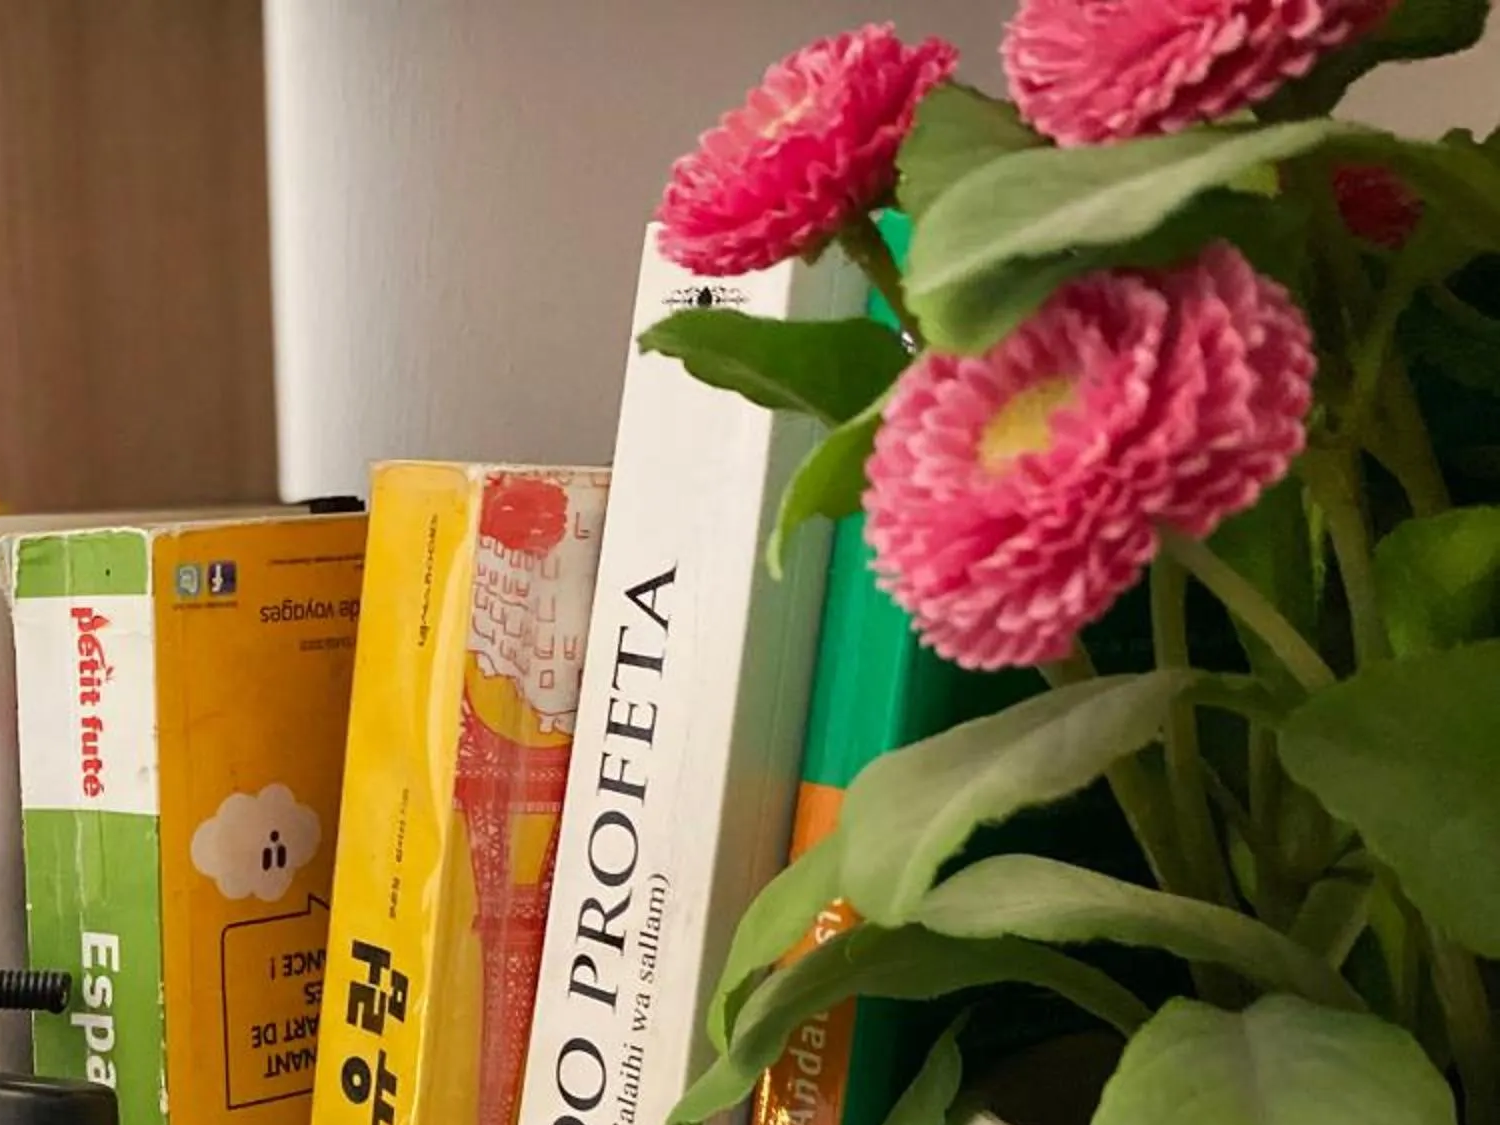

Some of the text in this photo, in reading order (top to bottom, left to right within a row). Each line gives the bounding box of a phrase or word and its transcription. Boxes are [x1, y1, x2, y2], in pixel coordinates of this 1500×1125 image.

[260, 598, 334, 624] voyages
[70, 607, 108, 798] petit futé
[567, 559, 678, 1014] PROFETA
[631, 985, 651, 1032] wa
[642, 872, 670, 982] sallam)
[252, 1023, 278, 1048] DE
